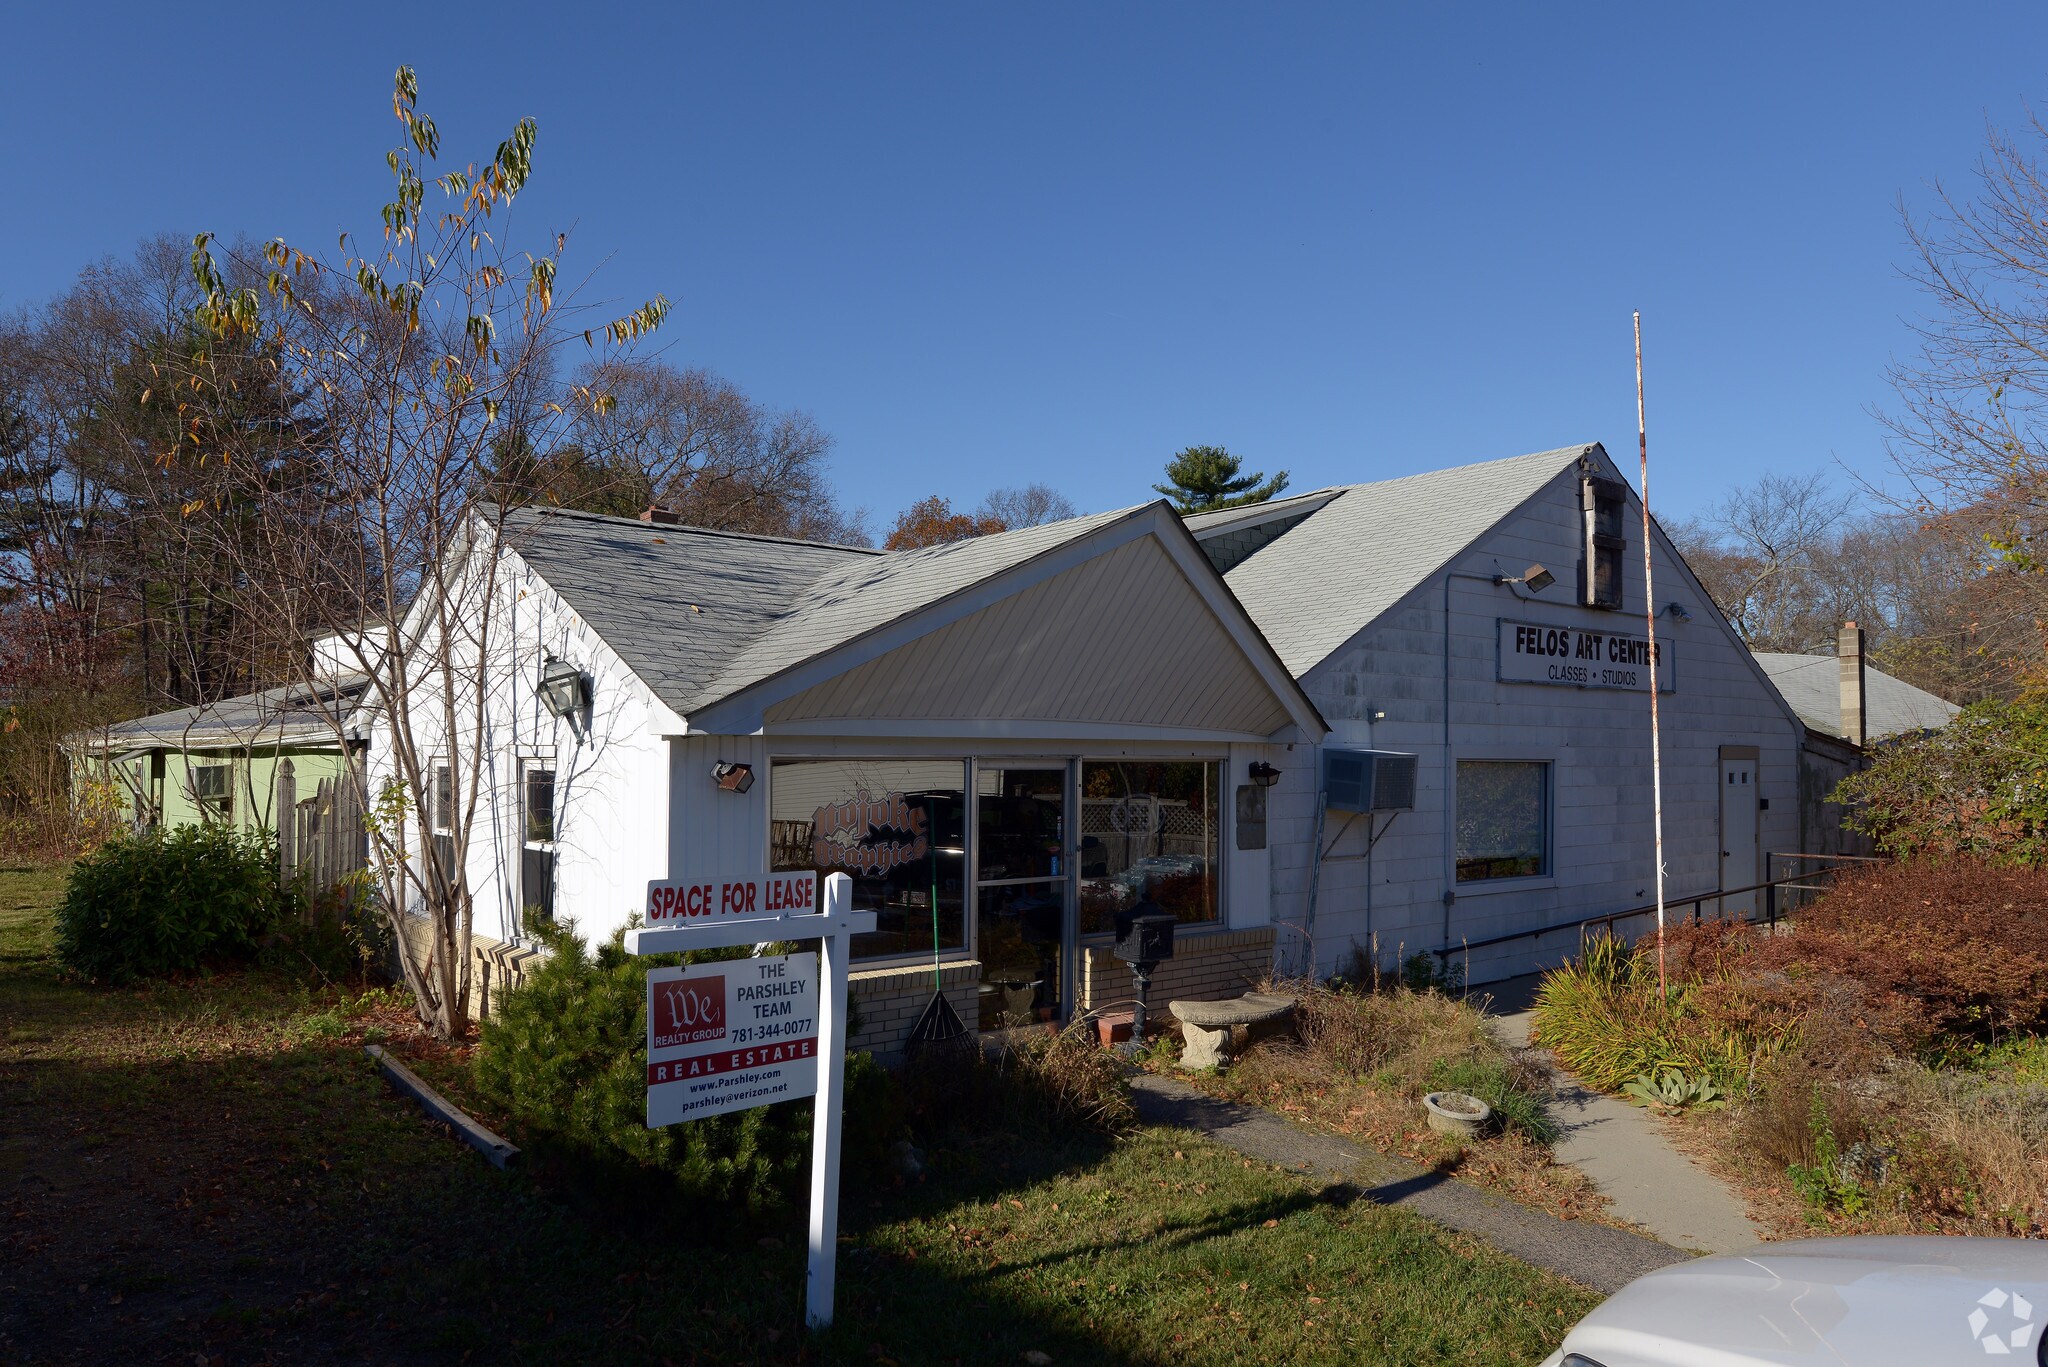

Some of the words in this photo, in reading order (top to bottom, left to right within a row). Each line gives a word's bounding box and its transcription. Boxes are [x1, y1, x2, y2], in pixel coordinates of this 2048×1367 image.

[1516, 626, 1569, 658] FELOS
[1575, 633, 1603, 660] ART
[1608, 637, 1661, 667] CENTER
[1548, 664, 1588, 682] CLASSES
[1602, 669, 1637, 686] STUDIOS
[650, 884, 713, 920] SPACE
[721, 882, 757, 914] FOR
[765, 878, 813, 911] LEASE
[758, 963, 785, 979] THE
[737, 979, 807, 1002] PARSHLEY
[753, 1001, 792, 1019] TEAM
[655, 1032, 690, 1047] REALTY
[692, 1027, 725, 1041] GROUP
[731, 1018, 812, 1044] 781-344-0077
[657, 1059, 715, 1081] REAL
[731, 1042, 809, 1068] ESTATE
[690, 1069, 781, 1093] www.Parshley.com
[682, 1082, 788, 1114] parshley@verizon.net
